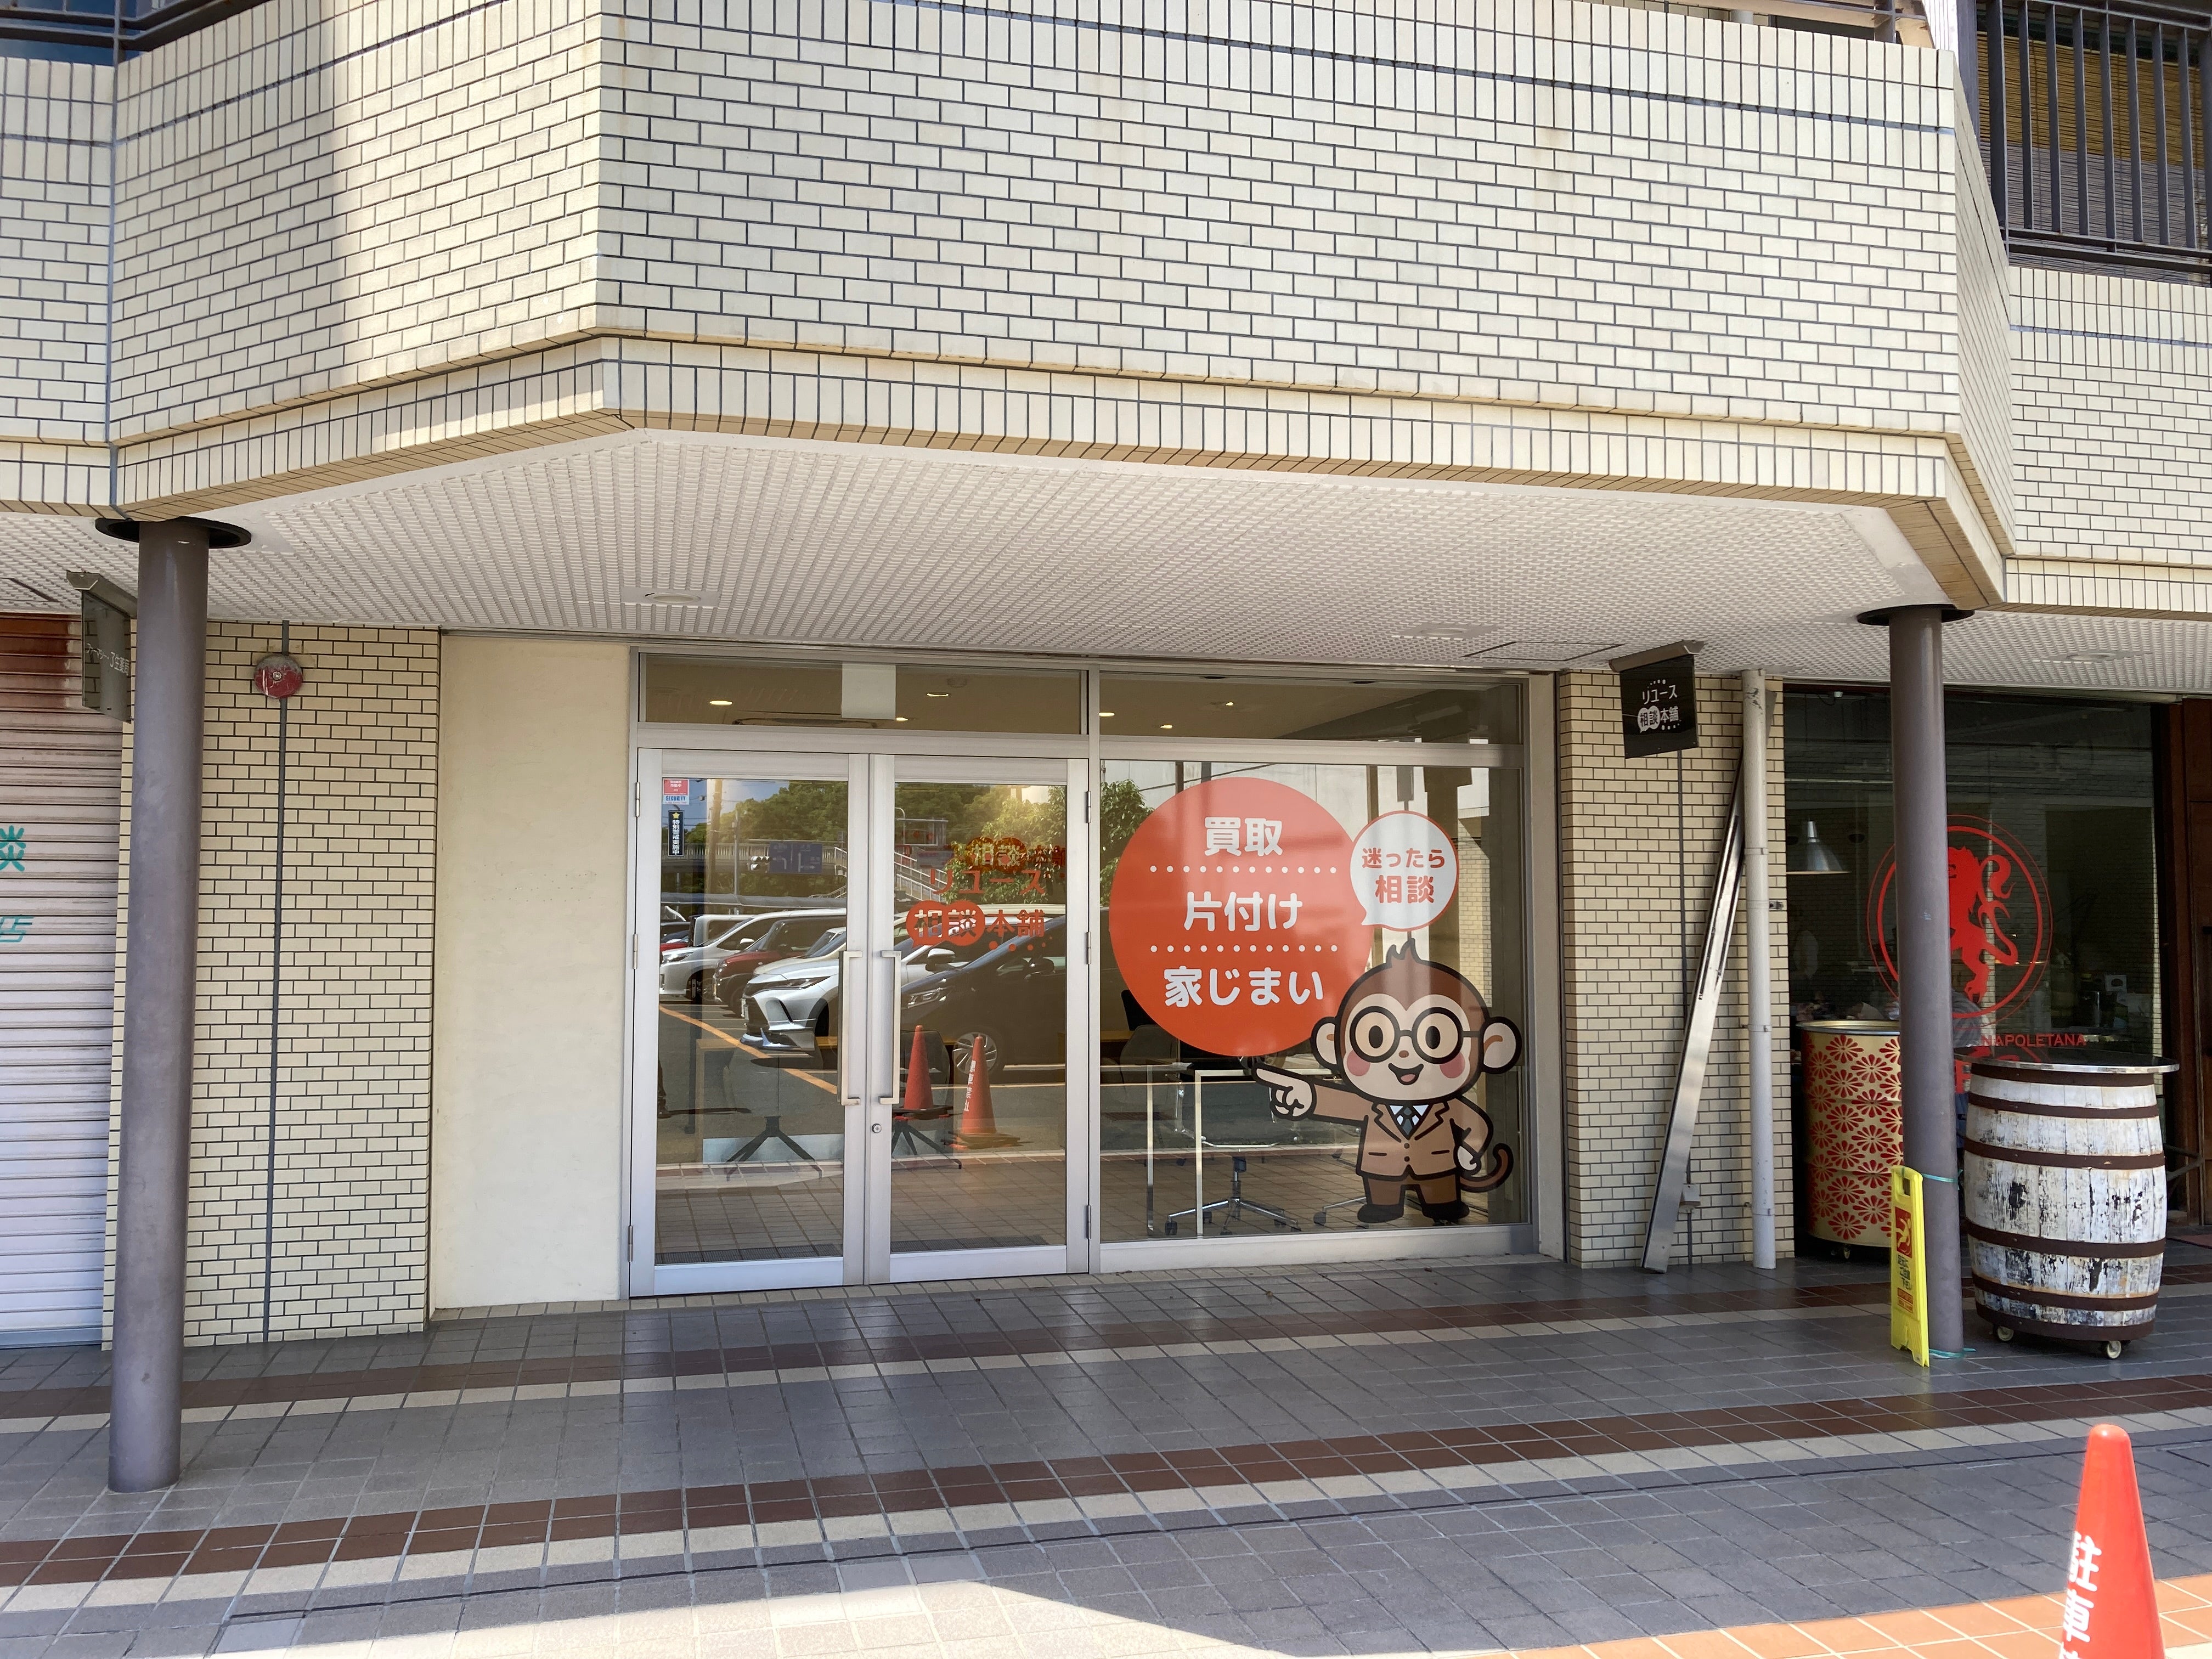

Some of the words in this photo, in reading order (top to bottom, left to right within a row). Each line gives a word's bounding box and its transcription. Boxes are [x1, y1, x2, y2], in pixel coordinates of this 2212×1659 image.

[1642, 685, 1678, 705] リユース
[1640, 706, 1679, 727] 相談本舗
[1204, 816, 1284, 857] 買取
[1361, 847, 1446, 870] 迷ったら
[929, 868, 1046, 895] リユース
[1374, 874, 1435, 905] 相談
[913, 908, 1046, 938] 相談本舗
[1183, 891, 1304, 932] 片付け
[1163, 965, 1324, 1008] 家じまい
[1980, 1032, 2087, 1047] NAPOLETANA
[2058, 1531, 2102, 1659] 駐車
